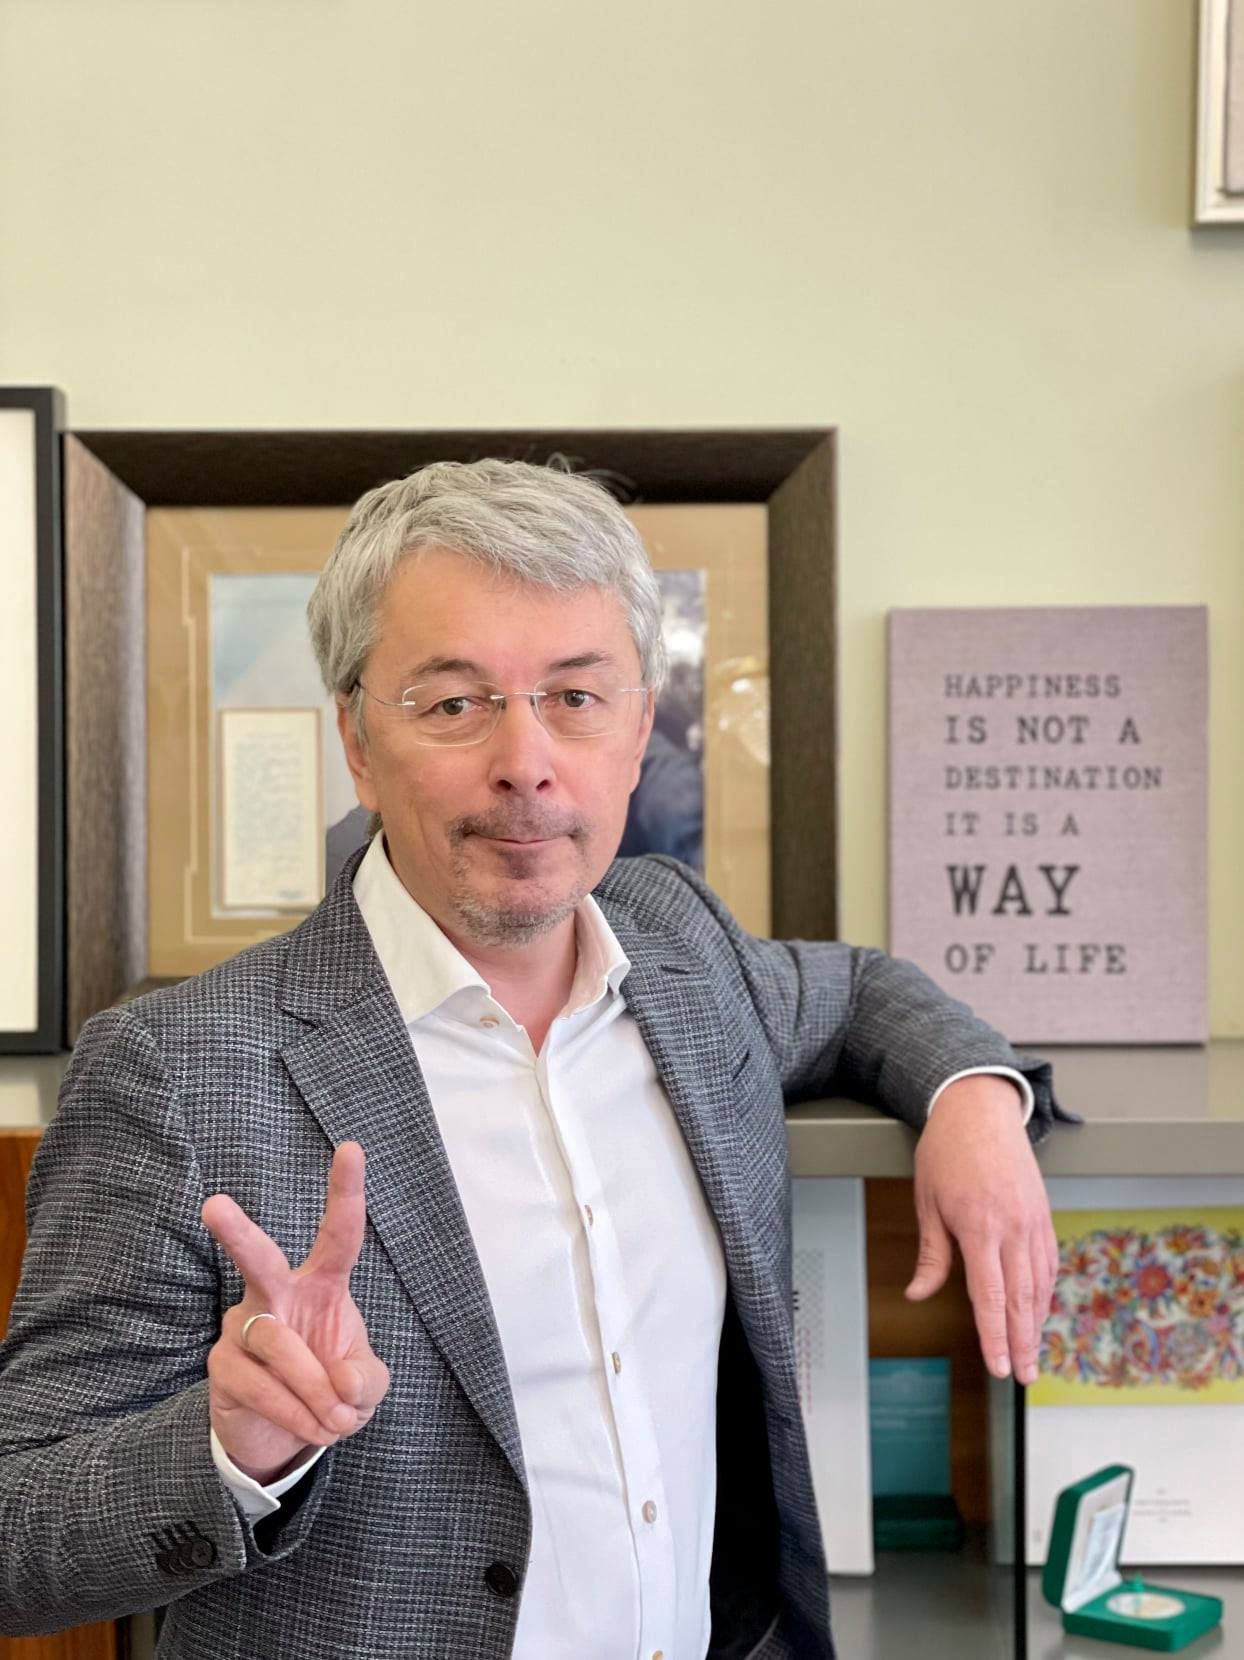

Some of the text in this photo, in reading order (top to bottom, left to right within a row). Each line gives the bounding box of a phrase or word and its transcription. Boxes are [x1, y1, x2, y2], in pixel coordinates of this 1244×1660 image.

[945, 674, 1121, 698] HAPPINESS
[946, 715, 1141, 745] IS NOT A
[945, 766, 1162, 790] DESTINATION
[946, 812, 1080, 836] IT IS A
[946, 864, 1081, 917] WAY
[945, 943, 1127, 974] OF LIFE
